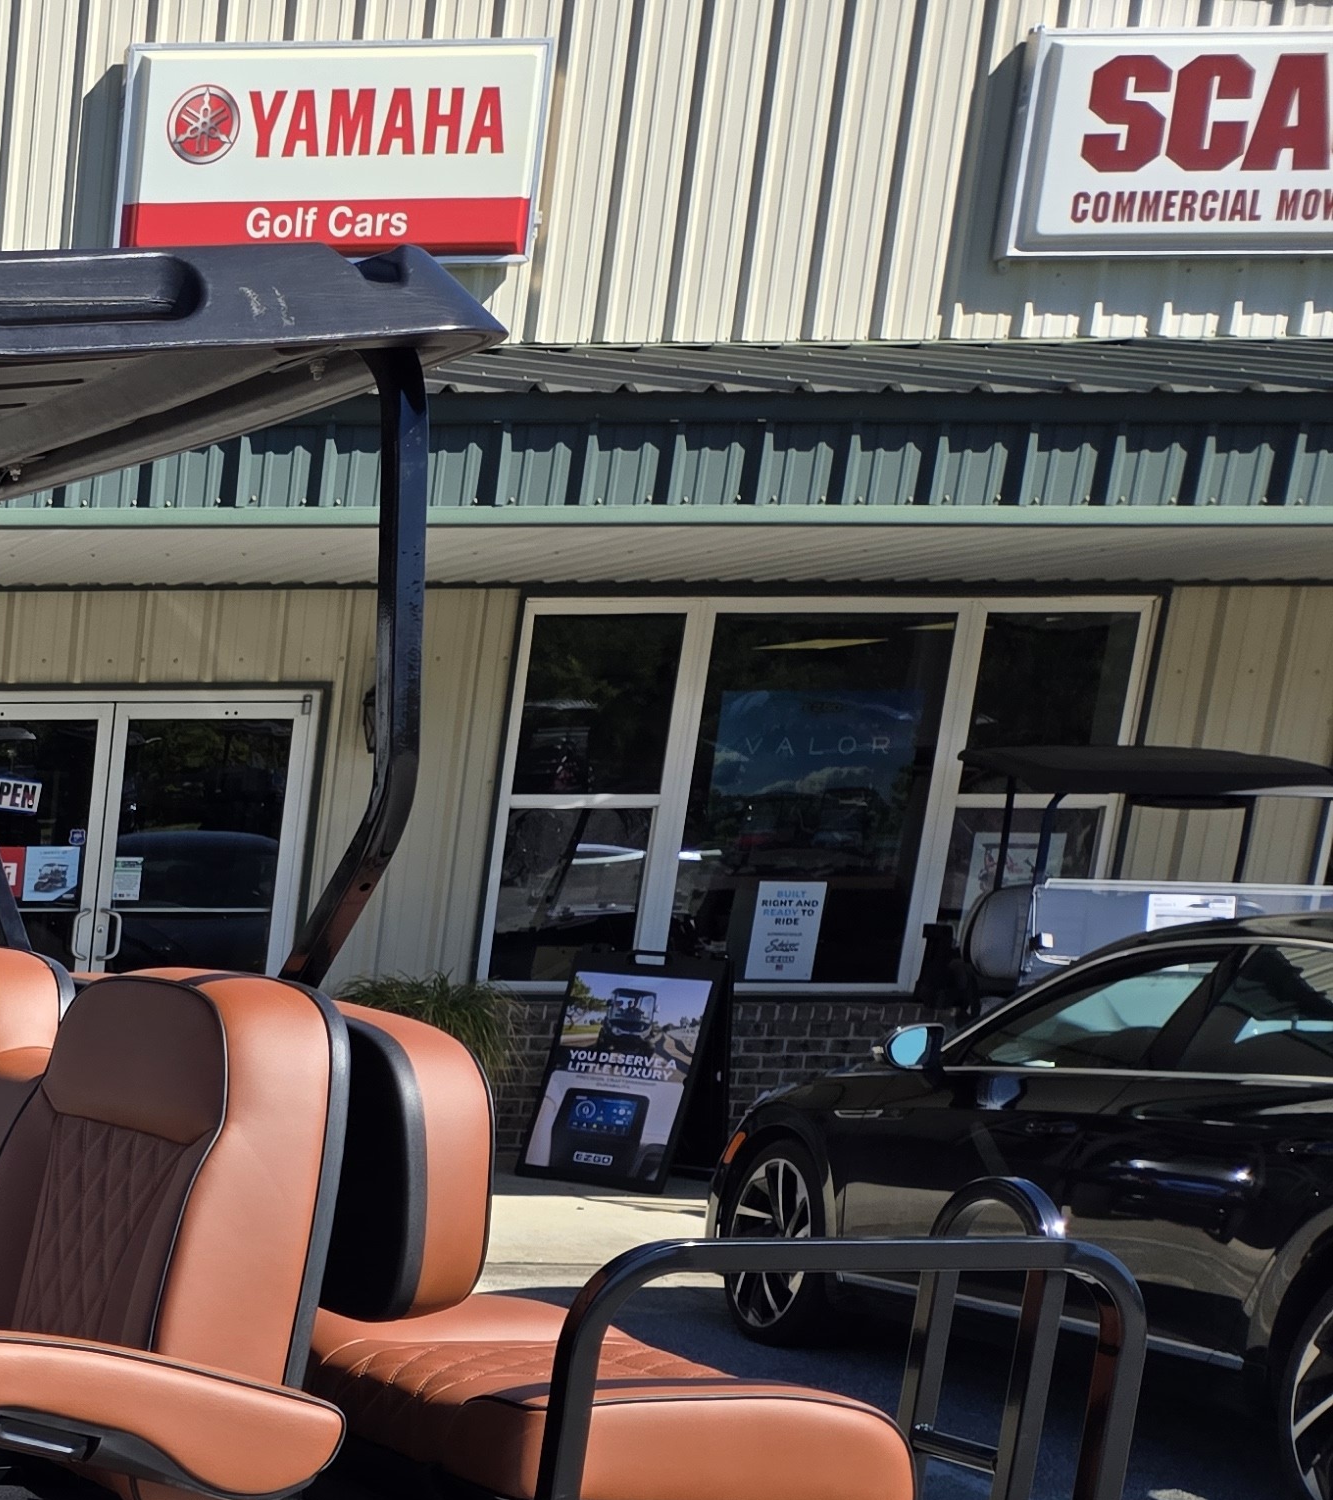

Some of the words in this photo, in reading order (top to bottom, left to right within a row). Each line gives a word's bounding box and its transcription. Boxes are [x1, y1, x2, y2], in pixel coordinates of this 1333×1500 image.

[249, 86, 505, 158] YAMAHA
[1070, 189, 1262, 223] COMMERCIAL
[245, 206, 318, 239] Golf
[328, 205, 409, 238] Cars
[745, 735, 891, 756] VALOR
[761, 899, 793, 907] RIGHT
[795, 899, 819, 907] AND
[776, 890, 806, 898] BUILT
[763, 908, 798, 916] READY
[801, 909, 815, 917] TO
[774, 918, 800, 926] RIDE
[569, 1049, 597, 1062] YOU
[599, 1052, 663, 1068] DESERVE
[665, 1059, 677, 1070] A
[568, 1061, 611, 1074] LITTLE
[613, 1066, 673, 1081] LUXURY
